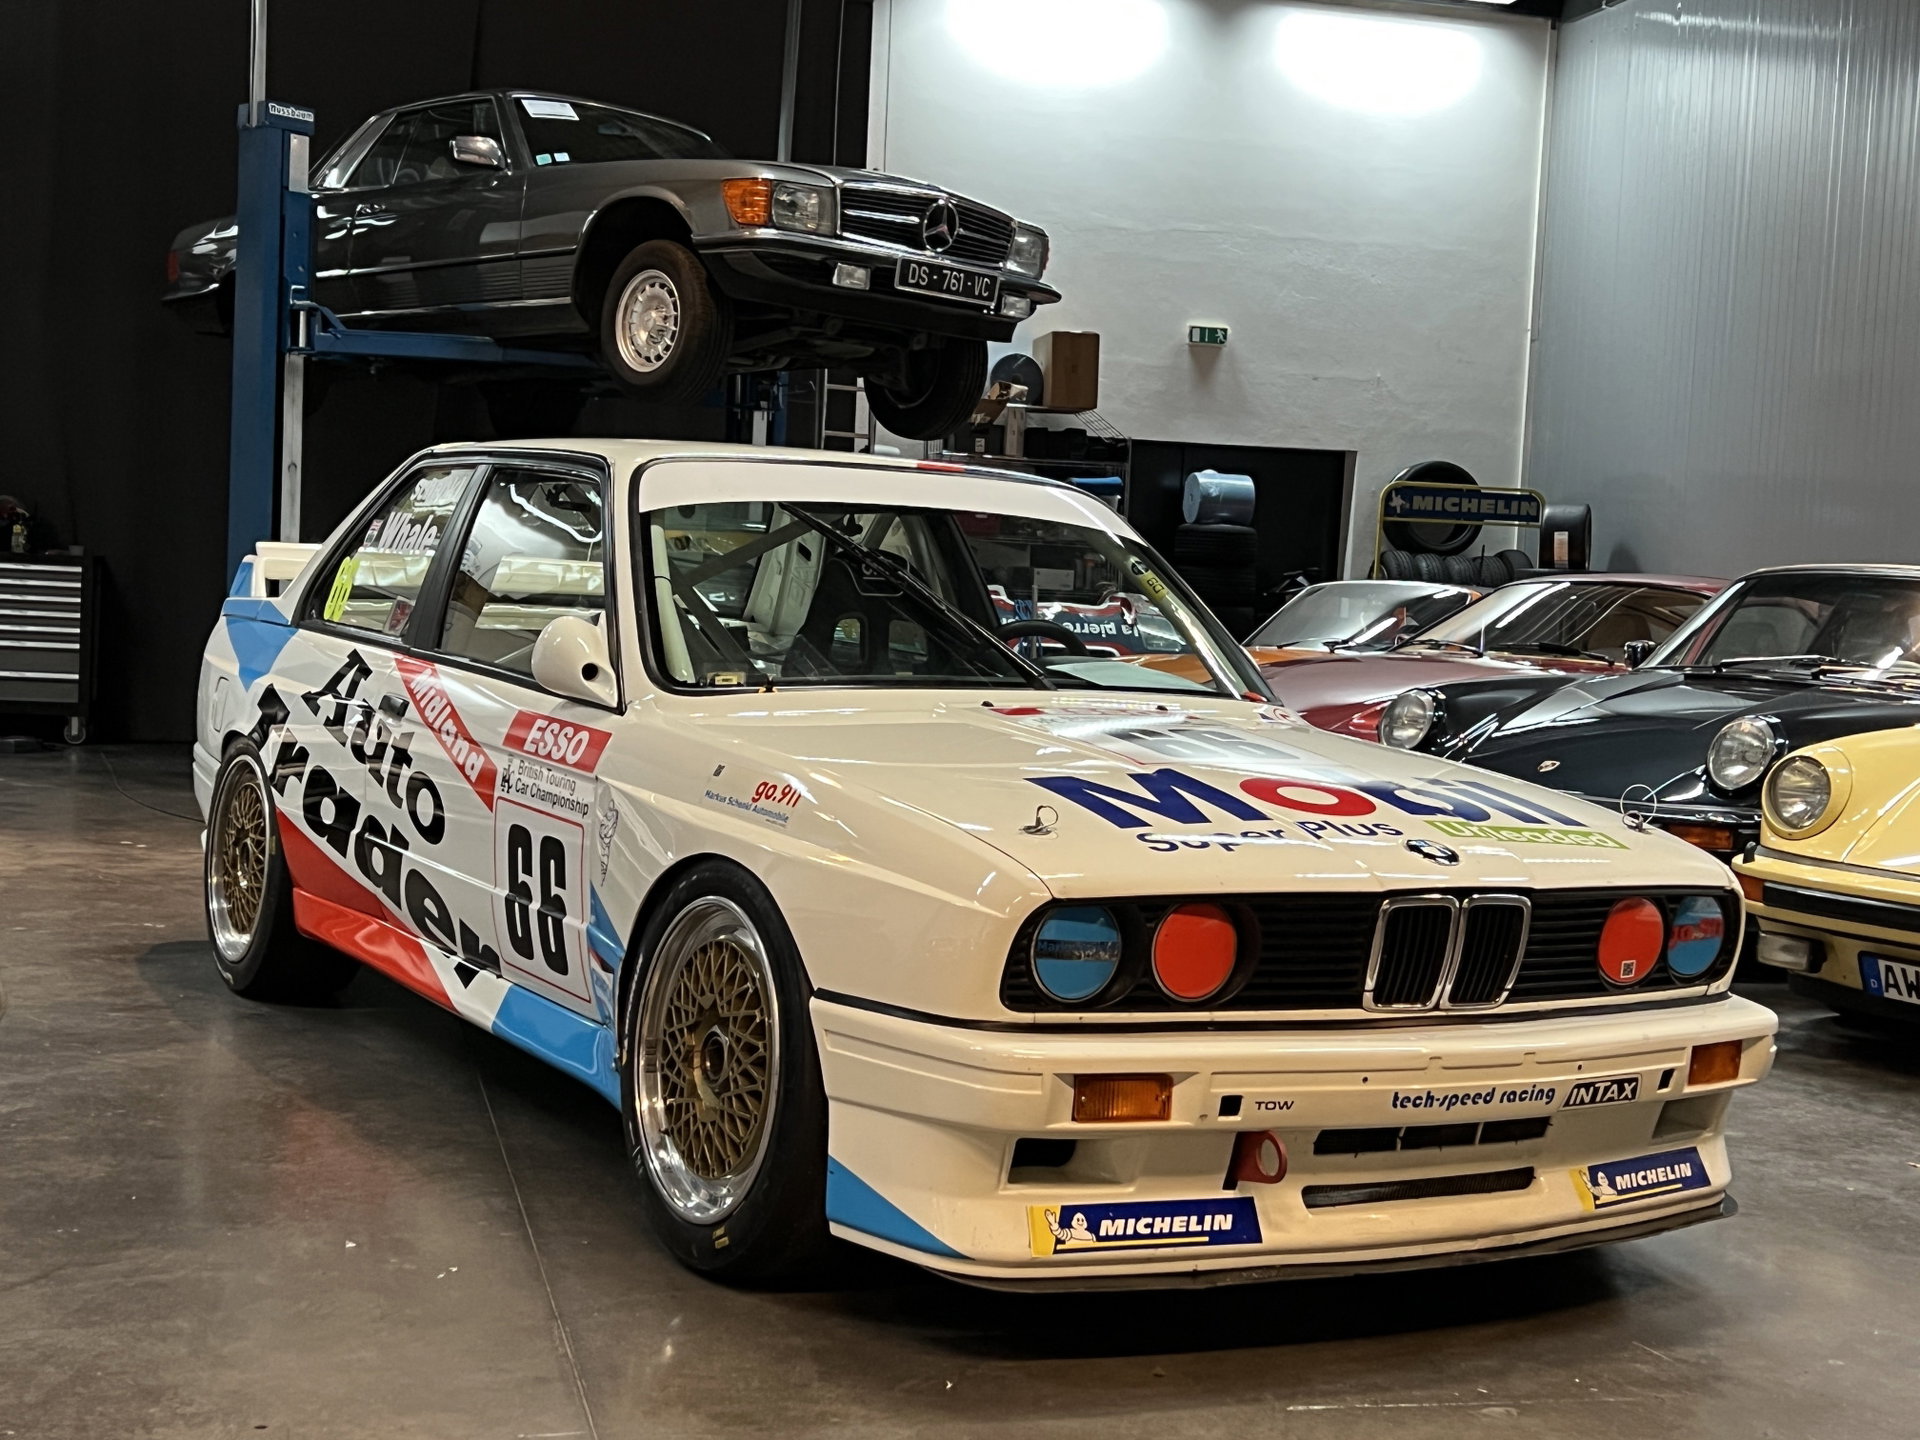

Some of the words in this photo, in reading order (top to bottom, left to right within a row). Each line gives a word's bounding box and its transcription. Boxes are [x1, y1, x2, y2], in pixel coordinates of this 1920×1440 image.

[1412, 495, 1537, 516] MICHELIN
[410, 668, 485, 782] Midland
[301, 648, 445, 845] Auto
[523, 719, 590, 765] ESSO
[518, 760, 544, 783] British
[546, 768, 577, 797] Touring
[515, 778, 530, 796] Car
[530, 782, 589, 819] Championship
[752, 781, 802, 808] go.911
[1023, 768, 1590, 829] Mobil
[1136, 829, 1287, 852] Super
[1294, 820, 1404, 839] Plus
[505, 824, 568, 976] 66
[1870, 978, 1878, 989] D
[1254, 1100, 1295, 1111] TOW
[1392, 1087, 1497, 1111] tech-speed
[1499, 1084, 1556, 1106] racing
[1567, 1080, 1638, 1106] INTAX
[1615, 1163, 1693, 1190] MICHELIN
[1099, 1213, 1233, 1237] MICHELIN
